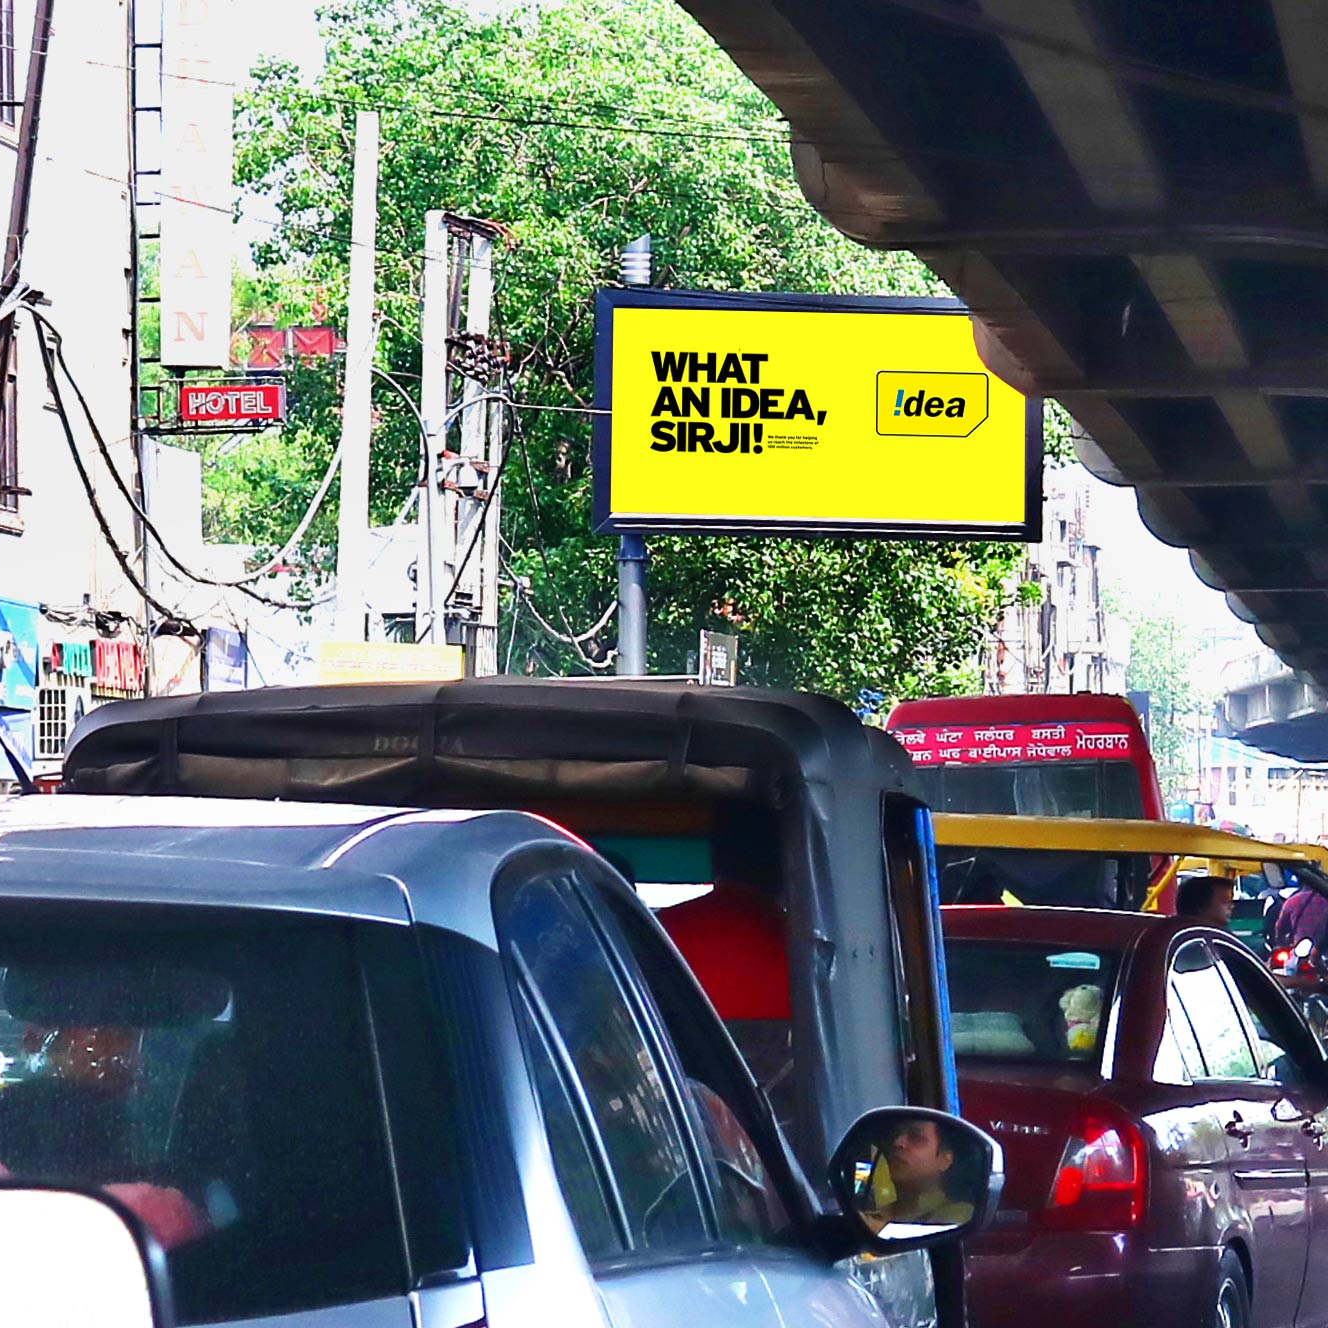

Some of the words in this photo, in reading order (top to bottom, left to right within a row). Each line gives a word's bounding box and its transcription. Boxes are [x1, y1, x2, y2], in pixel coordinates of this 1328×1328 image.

[651, 351, 768, 384] WHAT
[189, 390, 272, 415] HOTEL
[650, 386, 711, 418] AN
[721, 387, 828, 425] IDEA,
[650, 421, 764, 455] SIRJI!
